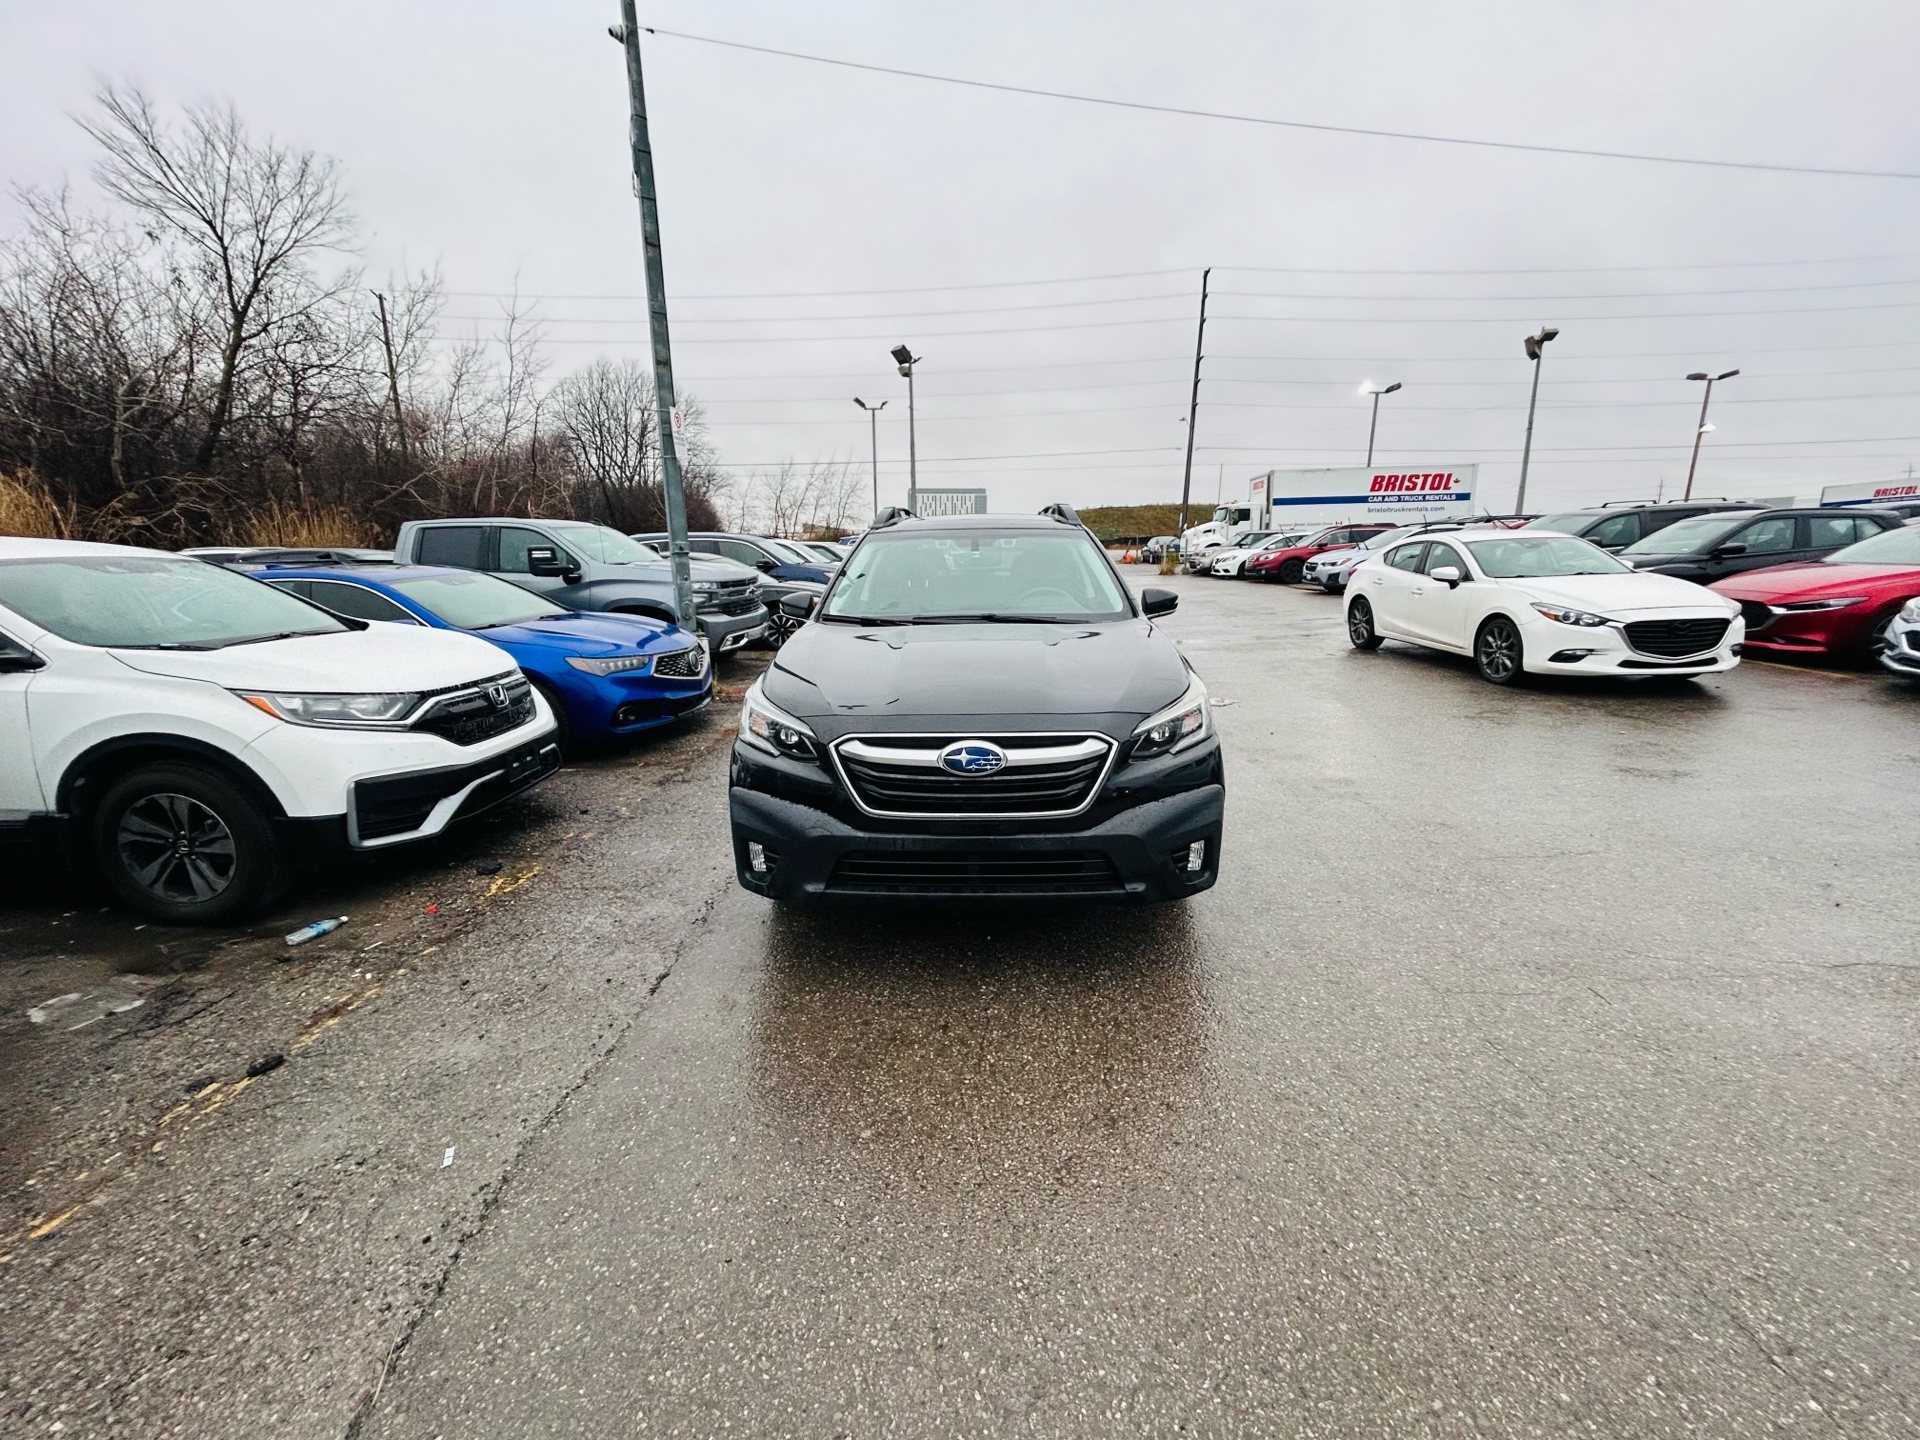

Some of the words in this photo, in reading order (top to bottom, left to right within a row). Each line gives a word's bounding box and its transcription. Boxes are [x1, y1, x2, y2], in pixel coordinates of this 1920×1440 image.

[1369, 472, 1453, 492] BRISTOL
[1873, 485, 1918, 497] BRISTOL
[1400, 494, 1424, 502] TRUCK
[1425, 493, 1456, 501] RENTALS
[1367, 505, 1445, 513] bristoltruckrentals.com
